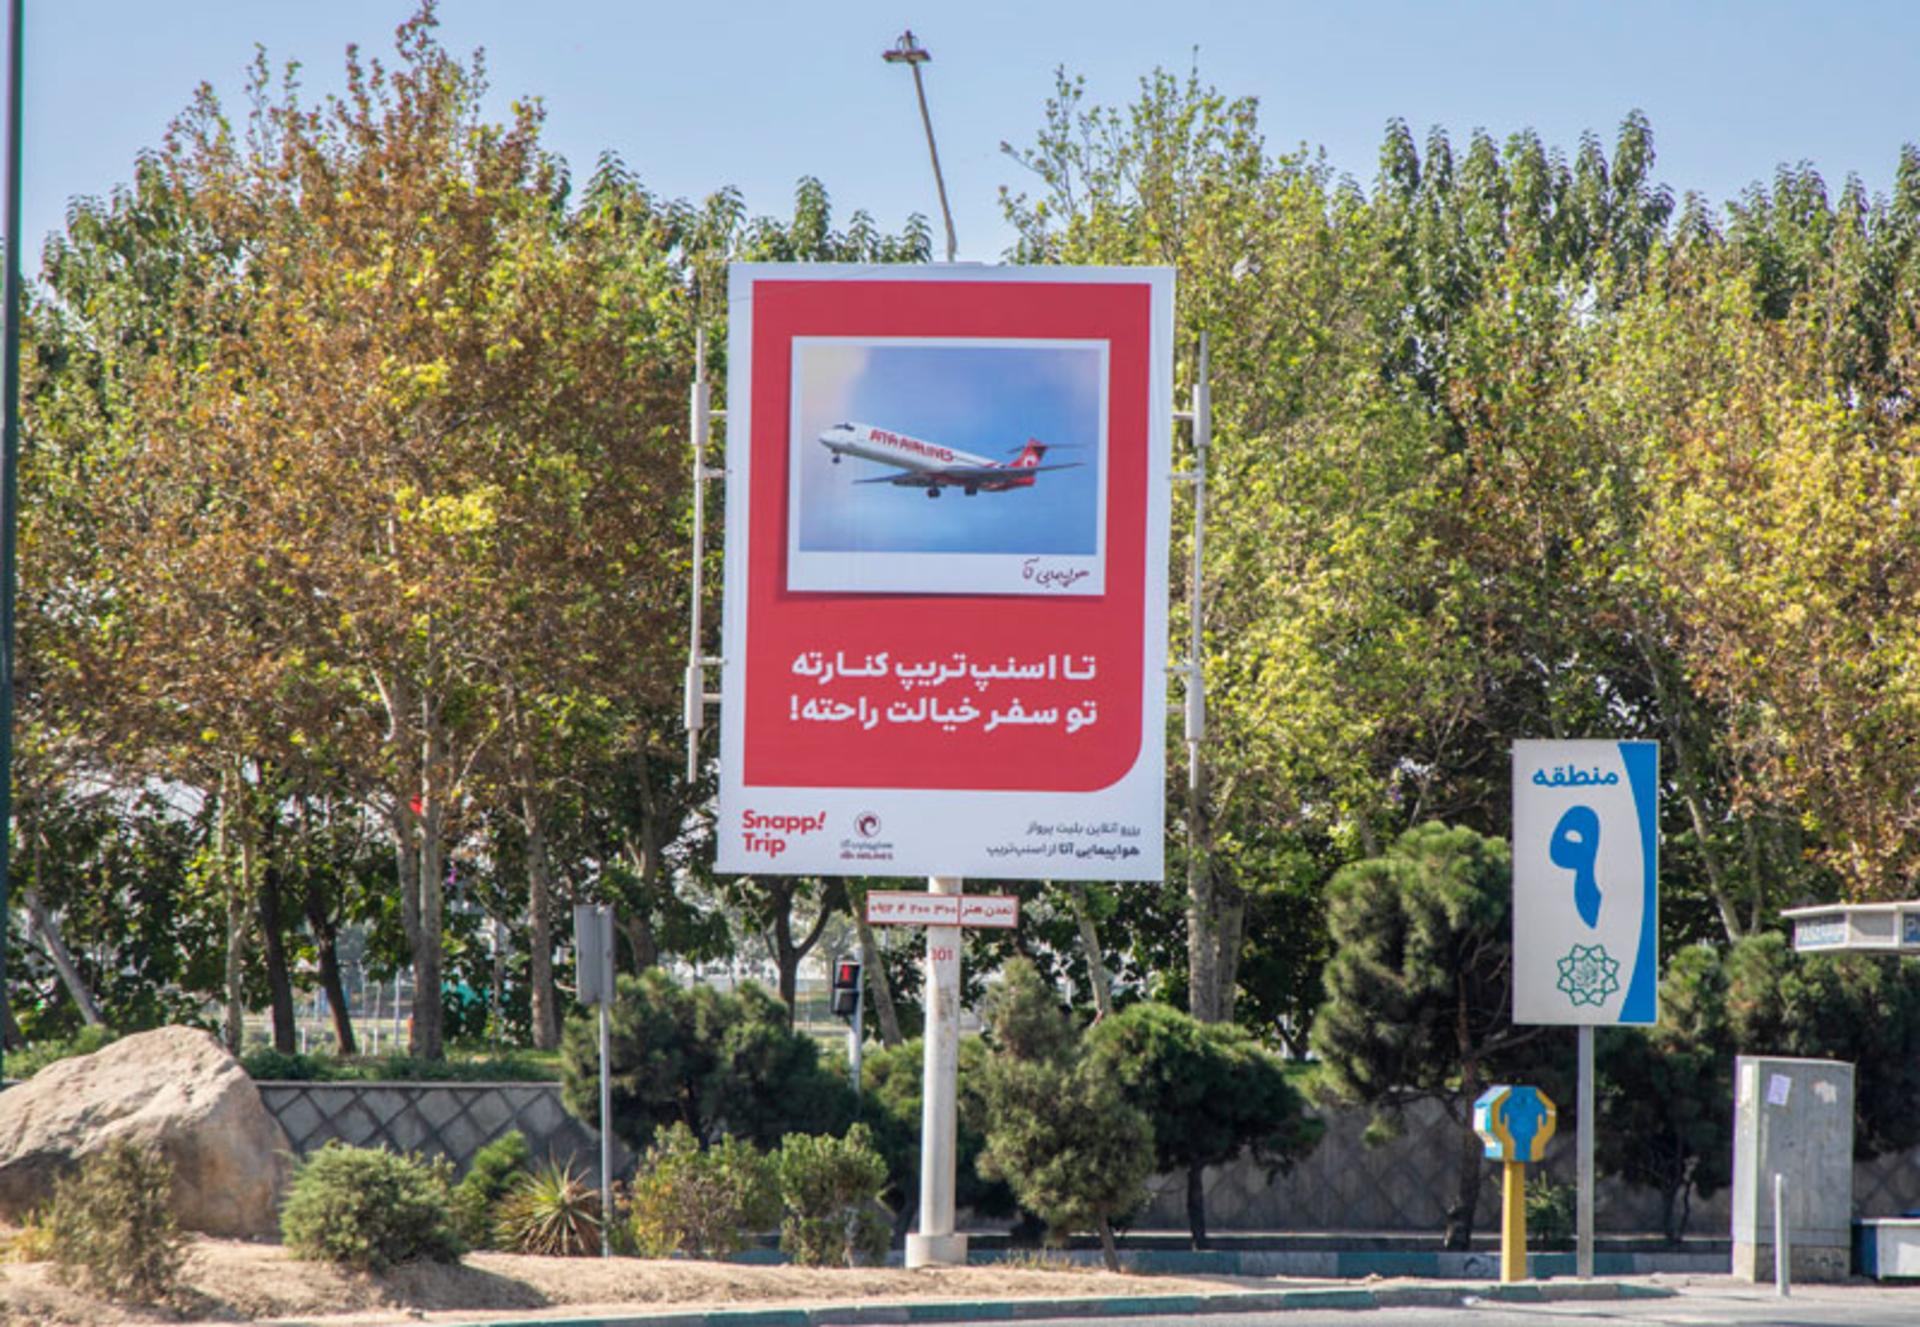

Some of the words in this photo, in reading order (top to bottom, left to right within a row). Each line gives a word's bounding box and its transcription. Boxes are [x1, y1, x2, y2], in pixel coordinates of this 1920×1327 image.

[869, 429, 898, 446] ATA
[900, 437, 954, 463] AIRLINES
[791, 651, 889, 685] کنارته
[1063, 653, 1097, 681] تا
[790, 694, 879, 730] راحته!
[886, 697, 981, 732] خیالت
[983, 697, 1059, 732] سفر
[1066, 700, 1098, 734] تو
[1532, 763, 1620, 788] منطقه
[741, 808, 827, 835] Snapp!
[741, 832, 787, 859] Trip
[1074, 843, 1140, 861] هواپیمایی
[1549, 804, 1603, 930] ۹
